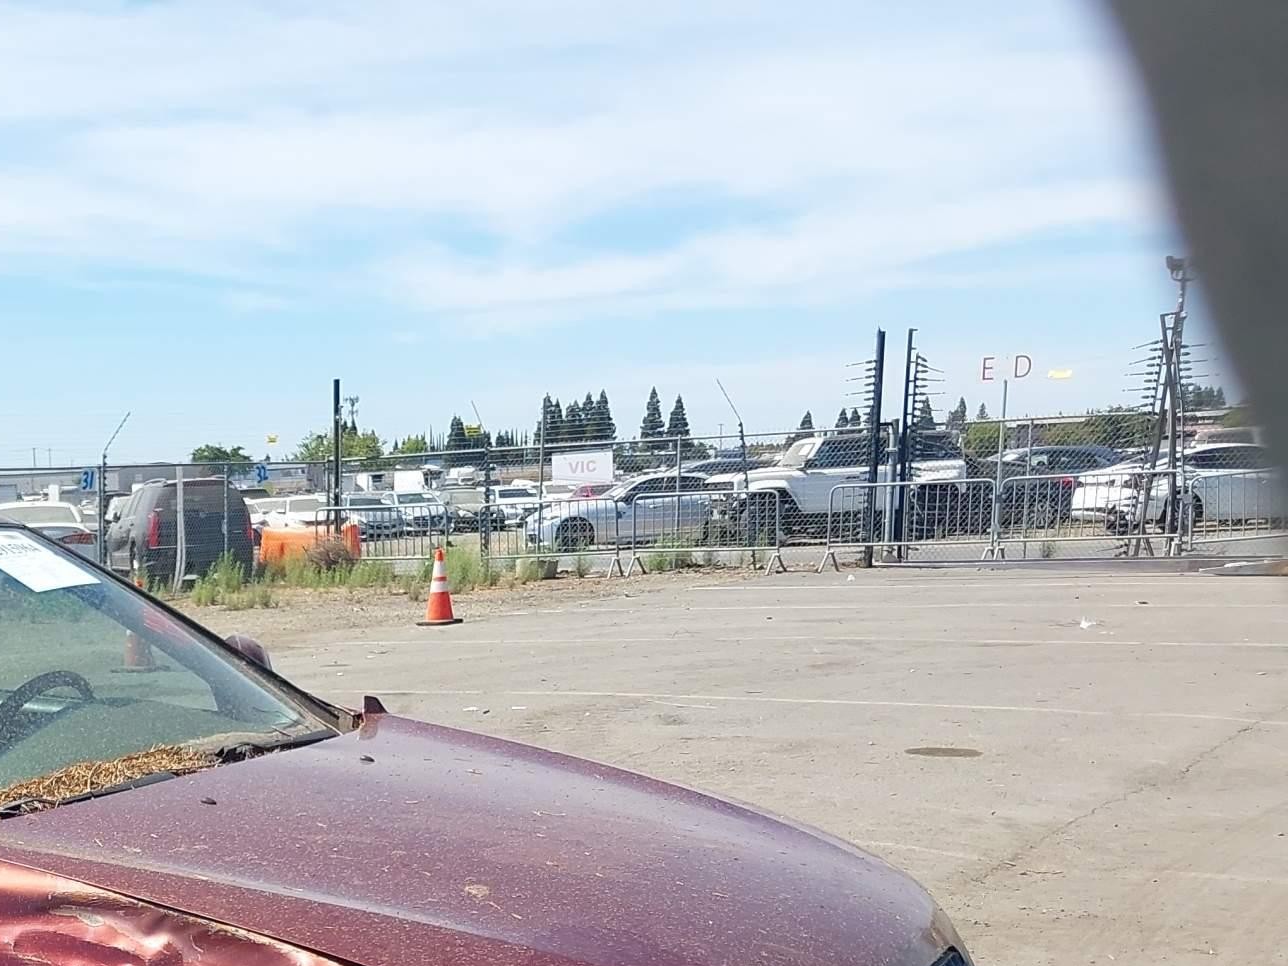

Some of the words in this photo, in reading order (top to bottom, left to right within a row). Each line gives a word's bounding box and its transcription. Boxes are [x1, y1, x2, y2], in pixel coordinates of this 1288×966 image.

[981, 357, 995, 381] E
[1013, 354, 1032, 379] D
[255, 464, 269, 484] 32
[568, 459, 598, 475] VIC
[81, 470, 94, 490] 31
